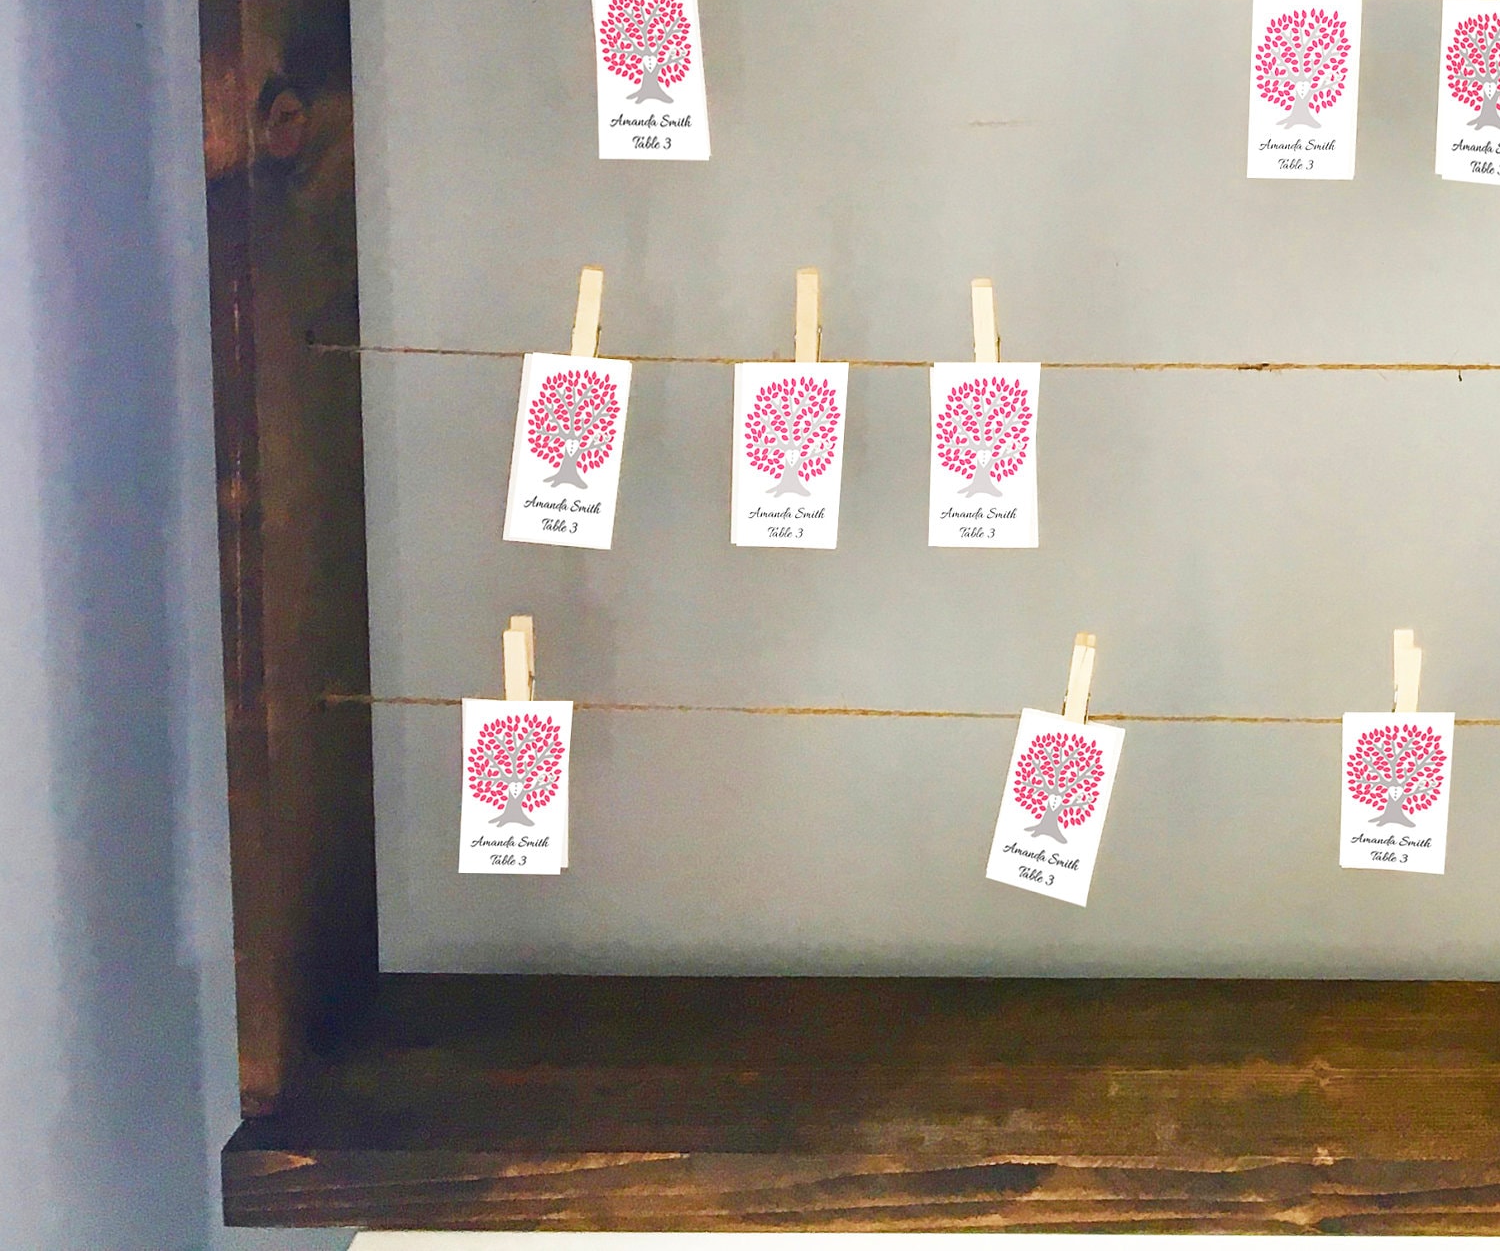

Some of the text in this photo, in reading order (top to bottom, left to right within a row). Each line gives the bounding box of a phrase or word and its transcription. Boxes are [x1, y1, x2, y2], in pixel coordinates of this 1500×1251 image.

[609, 113, 693, 129] Amanda Smith
[631, 135, 672, 150] Table 3
[1258, 138, 1336, 152] Amanda Smith
[1451, 138, 1495, 155] Amanda
[1277, 158, 1314, 170] Table 3
[1469, 160, 1495, 175] Table
[523, 495, 602, 515] Amanda Smith
[748, 506, 826, 520] Amanda Smith
[939, 507, 1018, 520] Amanda Smith
[541, 517, 579, 534] Table 3
[767, 526, 804, 538] Table 3
[959, 526, 996, 539] Table 3
[470, 835, 550, 849] Amanda Smith
[1350, 833, 1432, 848] Amanda Smith
[489, 854, 528, 866] Table 3
[1002, 842, 1080, 871] Amanda Smith
[1370, 850, 1409, 864] Table 3
[1018, 865, 1055, 886] Table 3
